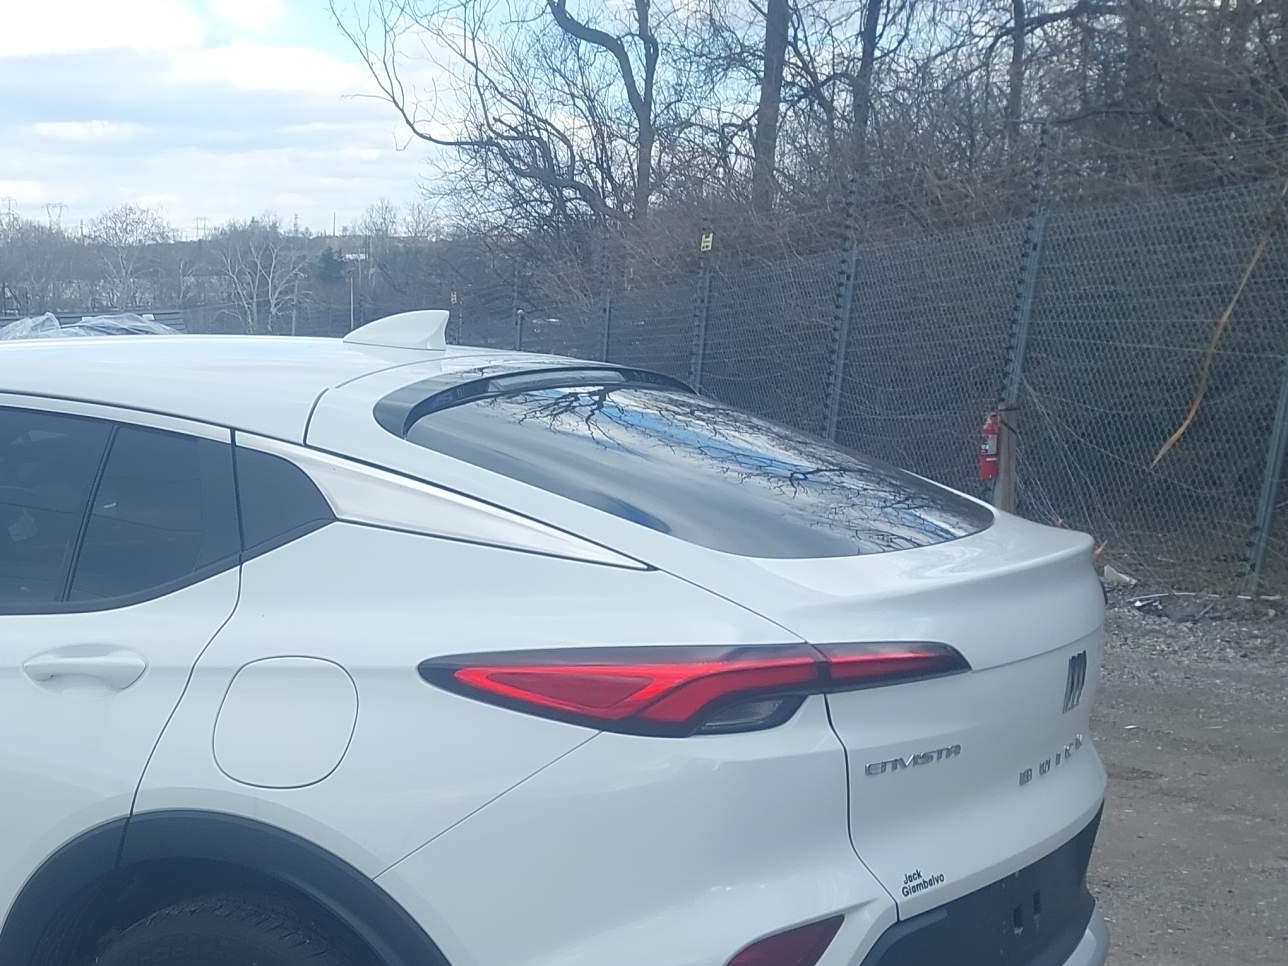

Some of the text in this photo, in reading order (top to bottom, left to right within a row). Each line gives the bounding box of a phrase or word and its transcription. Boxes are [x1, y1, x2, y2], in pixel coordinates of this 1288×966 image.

[864, 744, 961, 776] ENVISTA
[902, 873, 945, 897] Giambalvo
[903, 869, 922, 885] Jack
